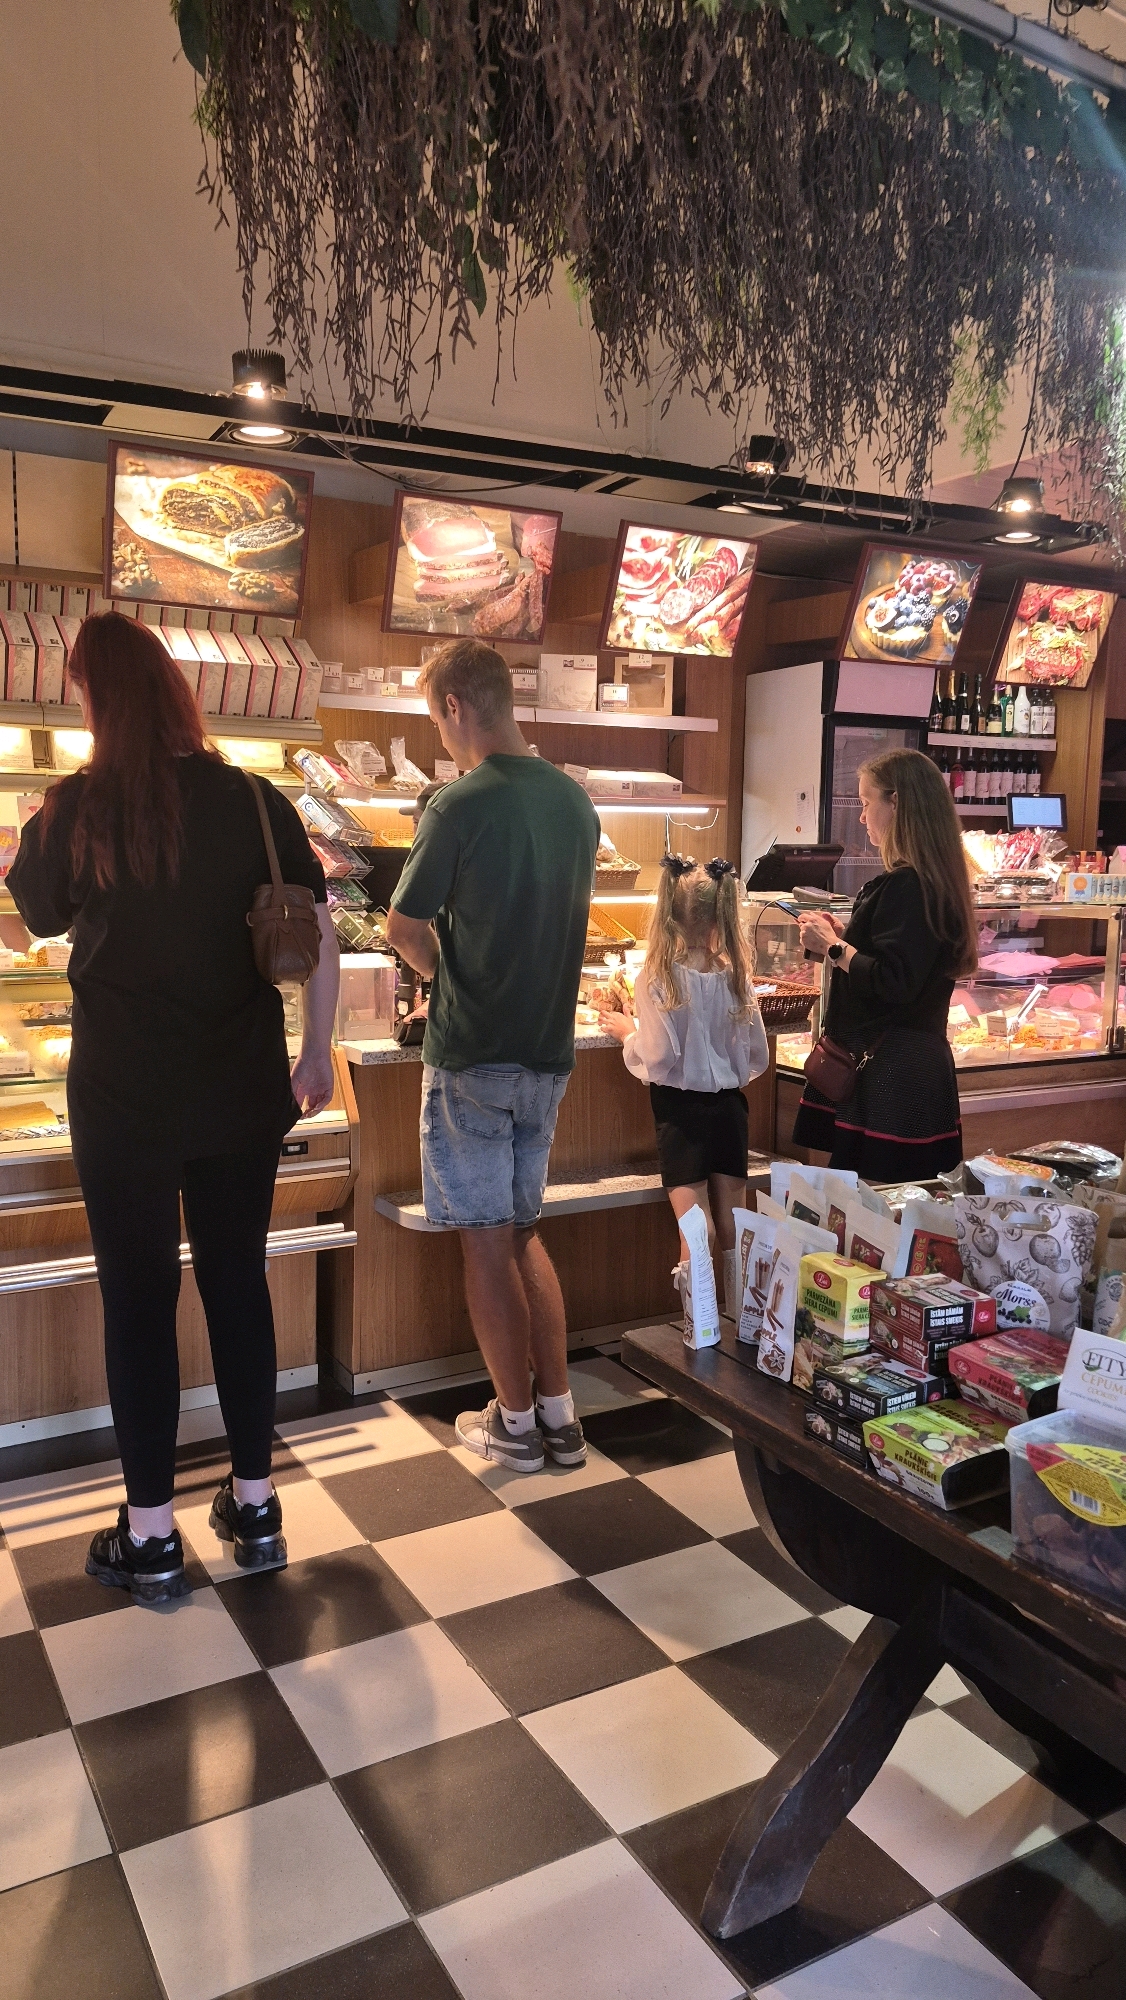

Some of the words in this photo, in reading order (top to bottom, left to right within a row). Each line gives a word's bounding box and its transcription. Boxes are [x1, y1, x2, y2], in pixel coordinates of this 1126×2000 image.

[804, 1296, 818, 1310] SIERA
[818, 1303, 838, 1319] CEPUMI
[806, 1288, 837, 1309] PARMEZĀNA
[996, 1288, 1037, 1308] Morss
[1013, 1385, 1022, 1396] &
[905, 1449, 929, 1468] PLĀNIE
